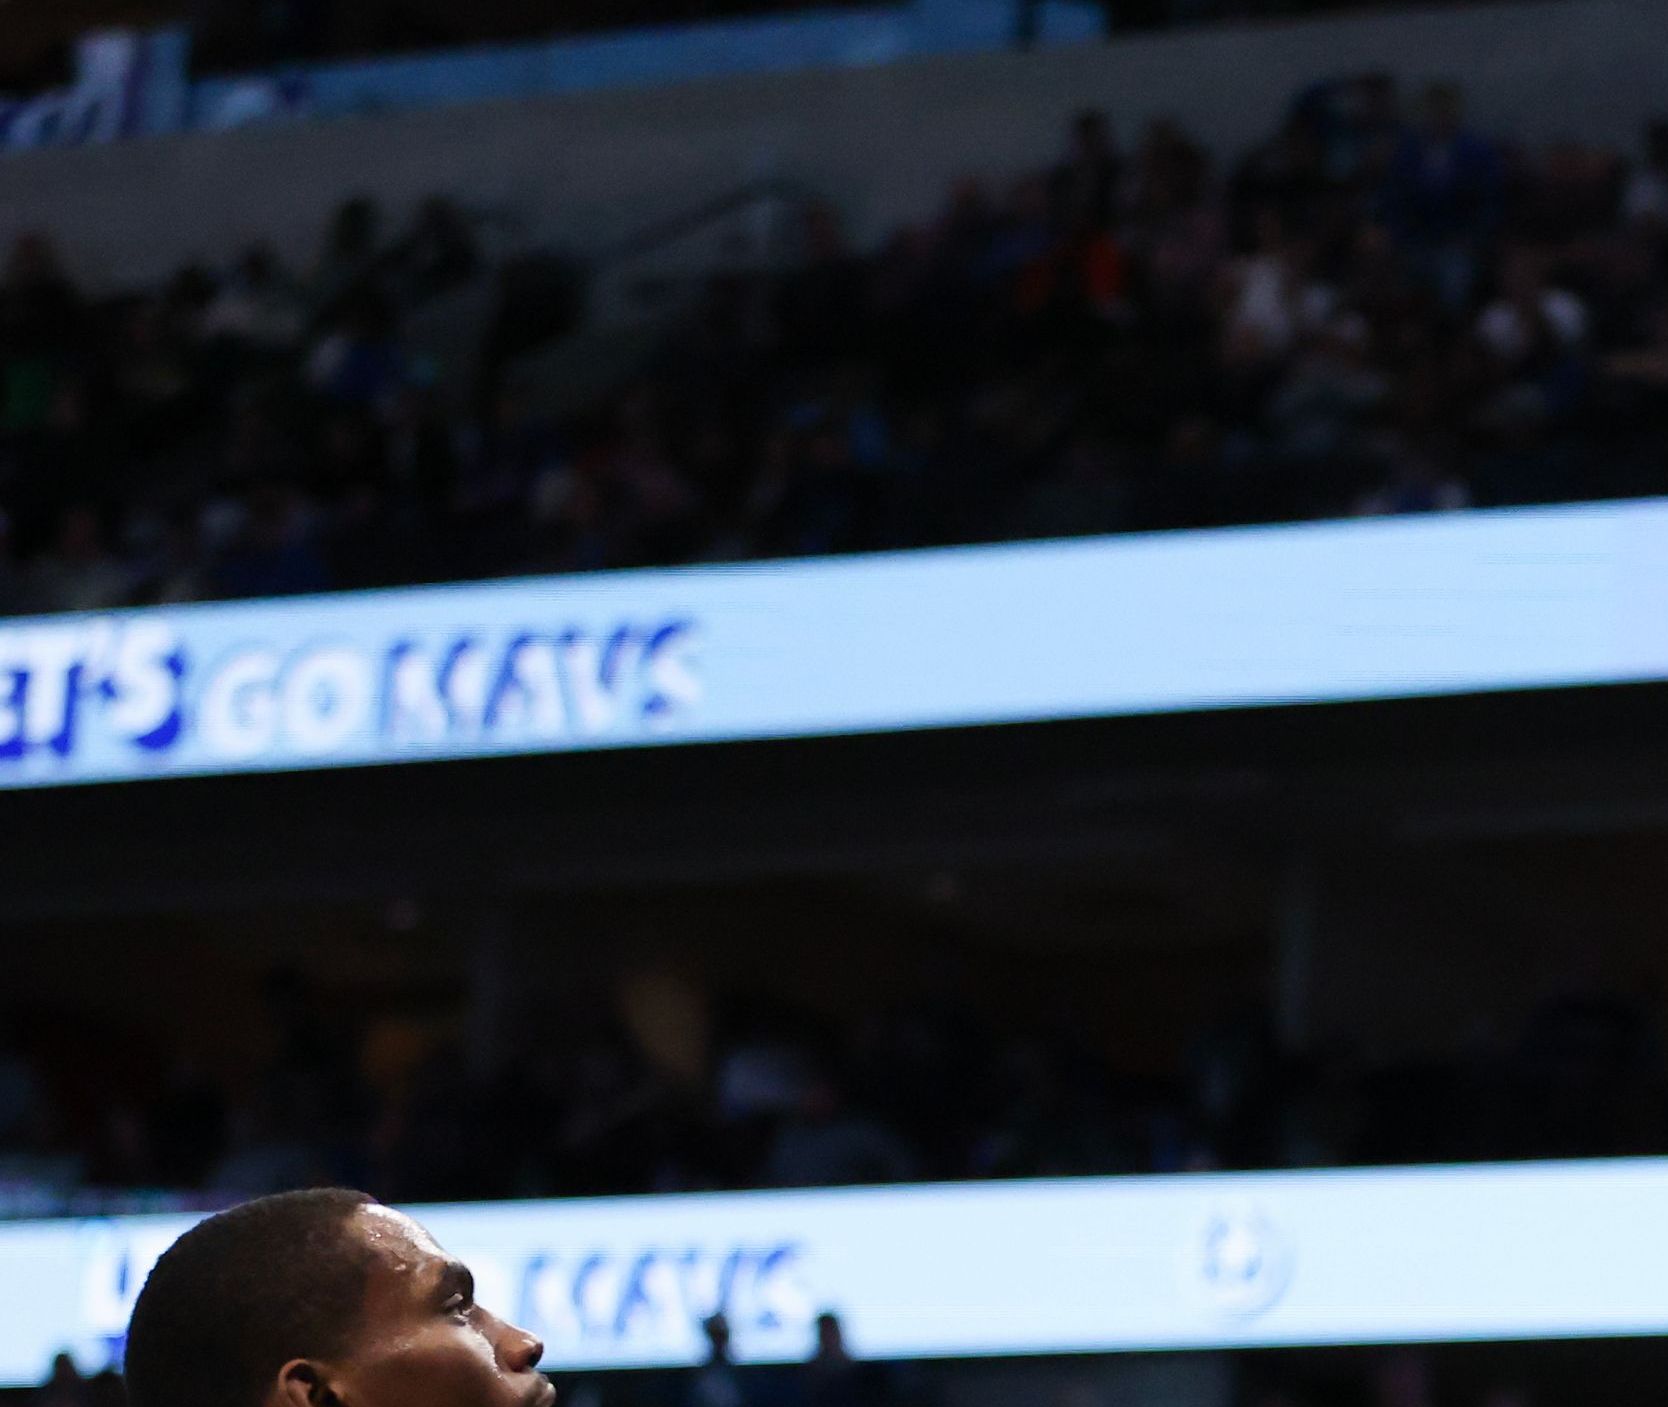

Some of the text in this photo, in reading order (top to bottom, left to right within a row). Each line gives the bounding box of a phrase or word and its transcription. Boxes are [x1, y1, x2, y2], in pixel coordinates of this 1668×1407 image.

[0, 616, 702, 757] T'S GO MAVS
